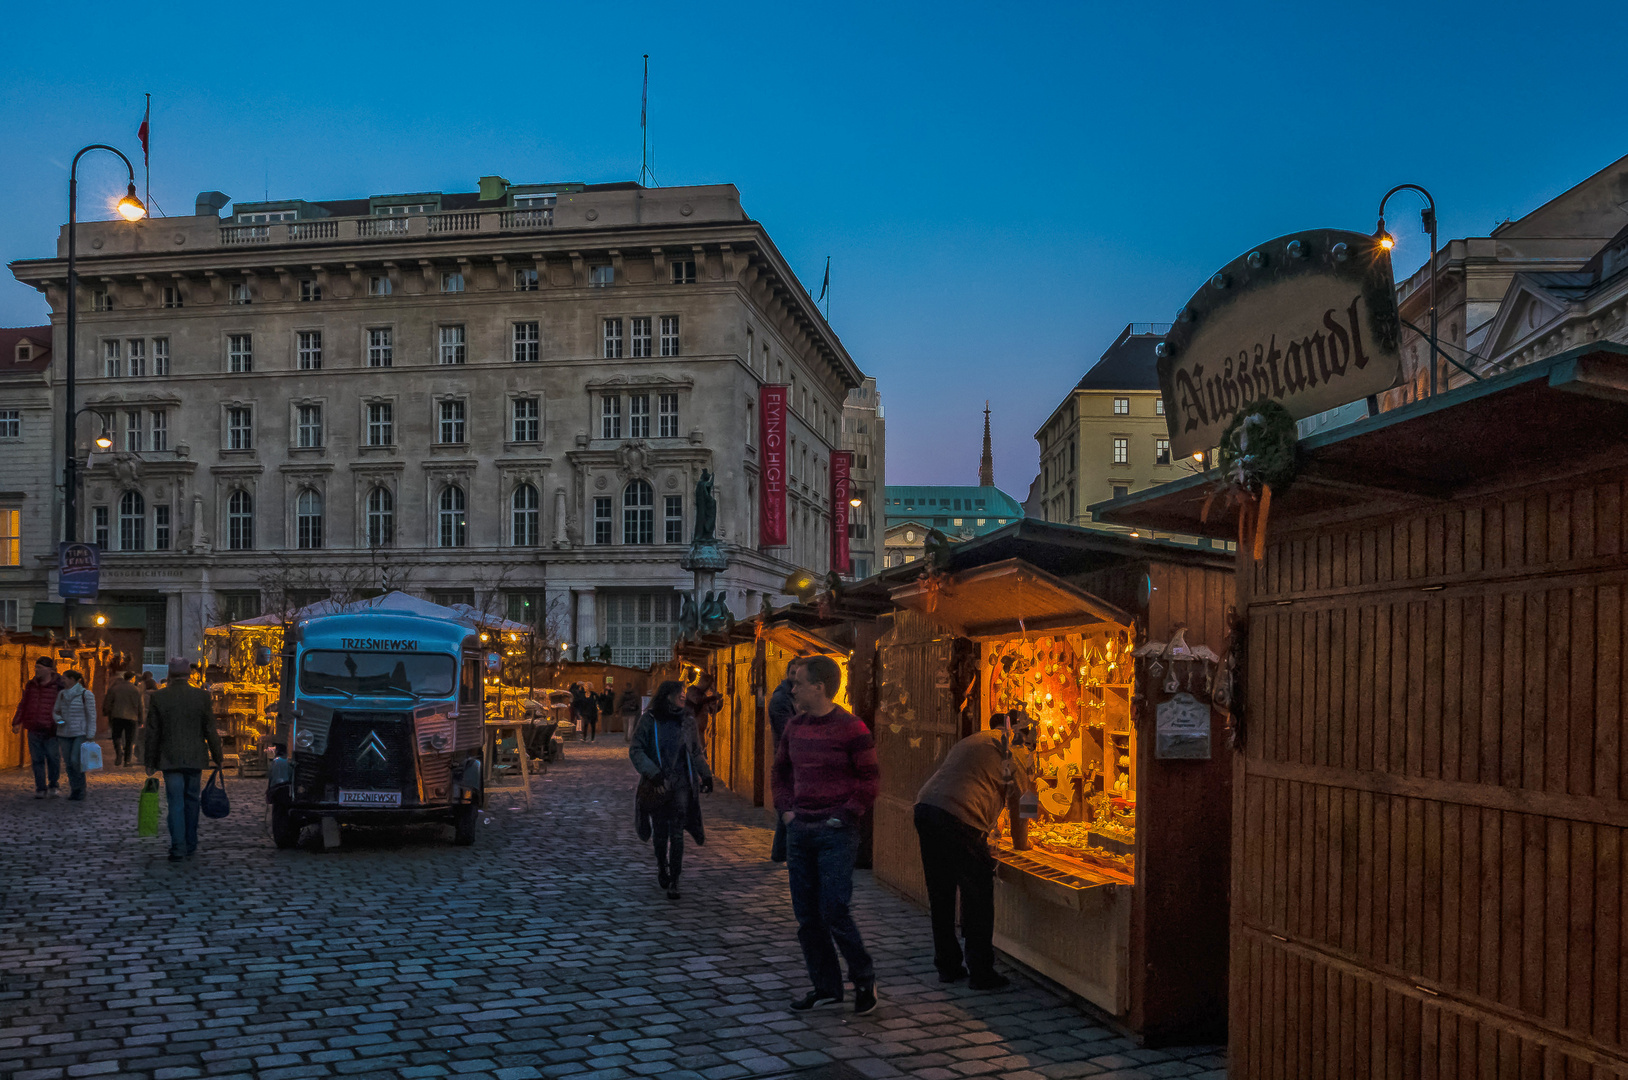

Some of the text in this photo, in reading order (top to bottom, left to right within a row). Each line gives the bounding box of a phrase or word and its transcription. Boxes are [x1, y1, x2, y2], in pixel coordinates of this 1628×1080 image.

[767, 394, 781, 447] FLYING
[767, 452, 781, 492] HIGH
[834, 457, 847, 498] FLYING
[834, 501, 845, 533] HIGH
[68, 549, 88, 557] TIME
